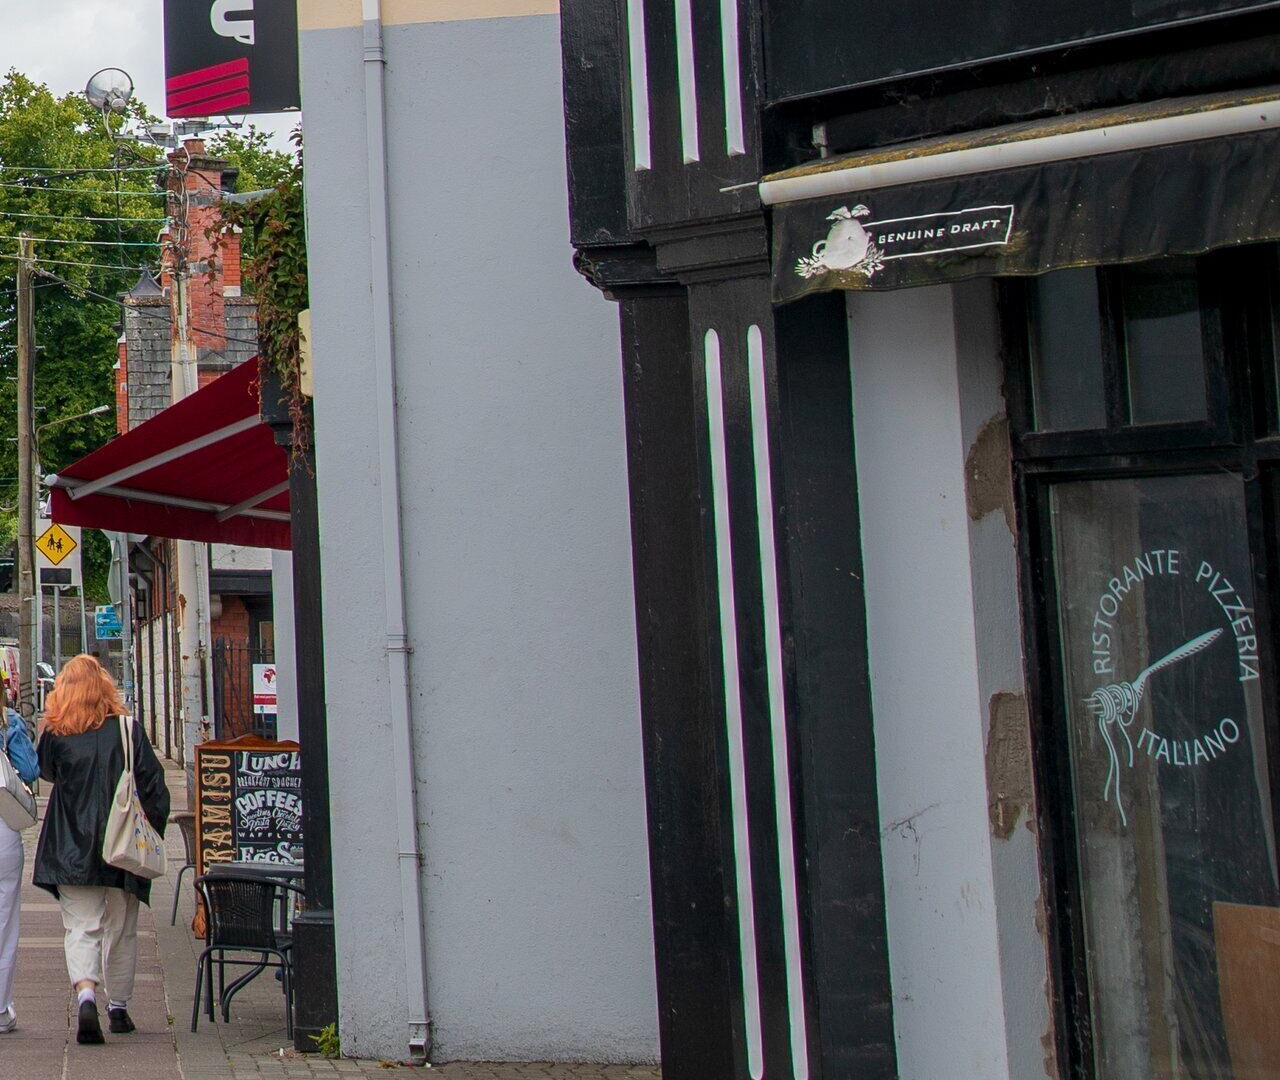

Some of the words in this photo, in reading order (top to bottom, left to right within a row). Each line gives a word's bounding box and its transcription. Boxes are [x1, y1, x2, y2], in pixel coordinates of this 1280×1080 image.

[878, 228, 945, 244] GENUINE
[950, 220, 1001, 234] DRAFT
[1092, 549, 1180, 675] RISTORANTE
[1195, 560, 1261, 682] PIZZERIA
[1137, 718, 1239, 766] ITALIANO
[239, 751, 301, 776] LUNCH
[202, 753, 236, 875] RAMISU
[235, 790, 303, 816] COFFEES
[240, 841, 295, 866] EGGS
